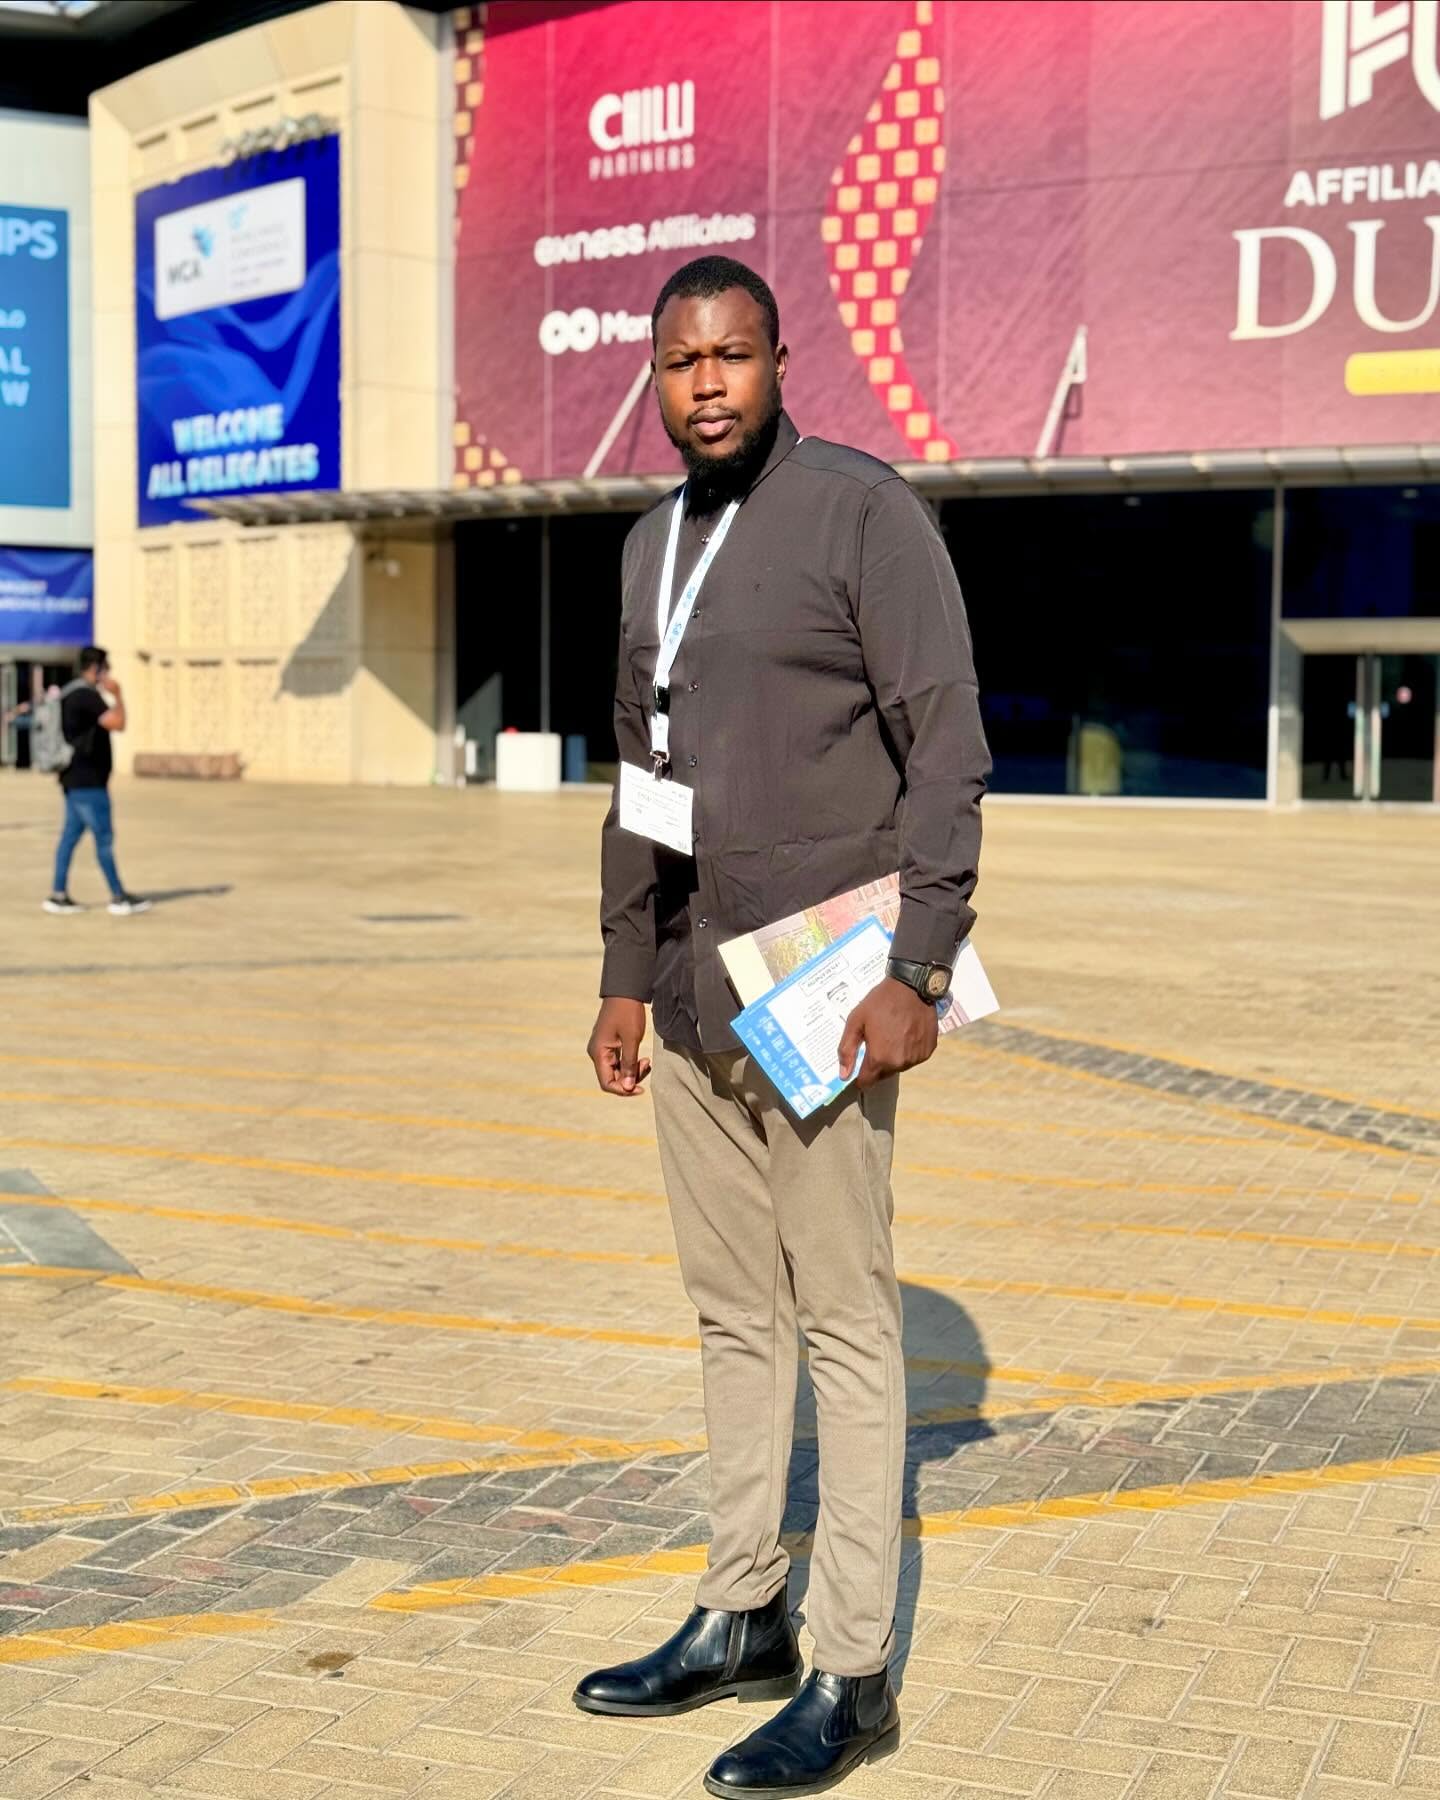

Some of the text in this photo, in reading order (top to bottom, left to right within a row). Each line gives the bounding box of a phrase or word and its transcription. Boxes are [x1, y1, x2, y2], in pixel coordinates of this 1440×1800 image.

[588, 142, 696, 182] PARTNERS
[1283, 160, 1440, 208] AFFILIA
[534, 223, 646, 267] exness
[172, 403, 284, 454] WELCOME
[147, 442, 319, 499] ALL DELEGATES
